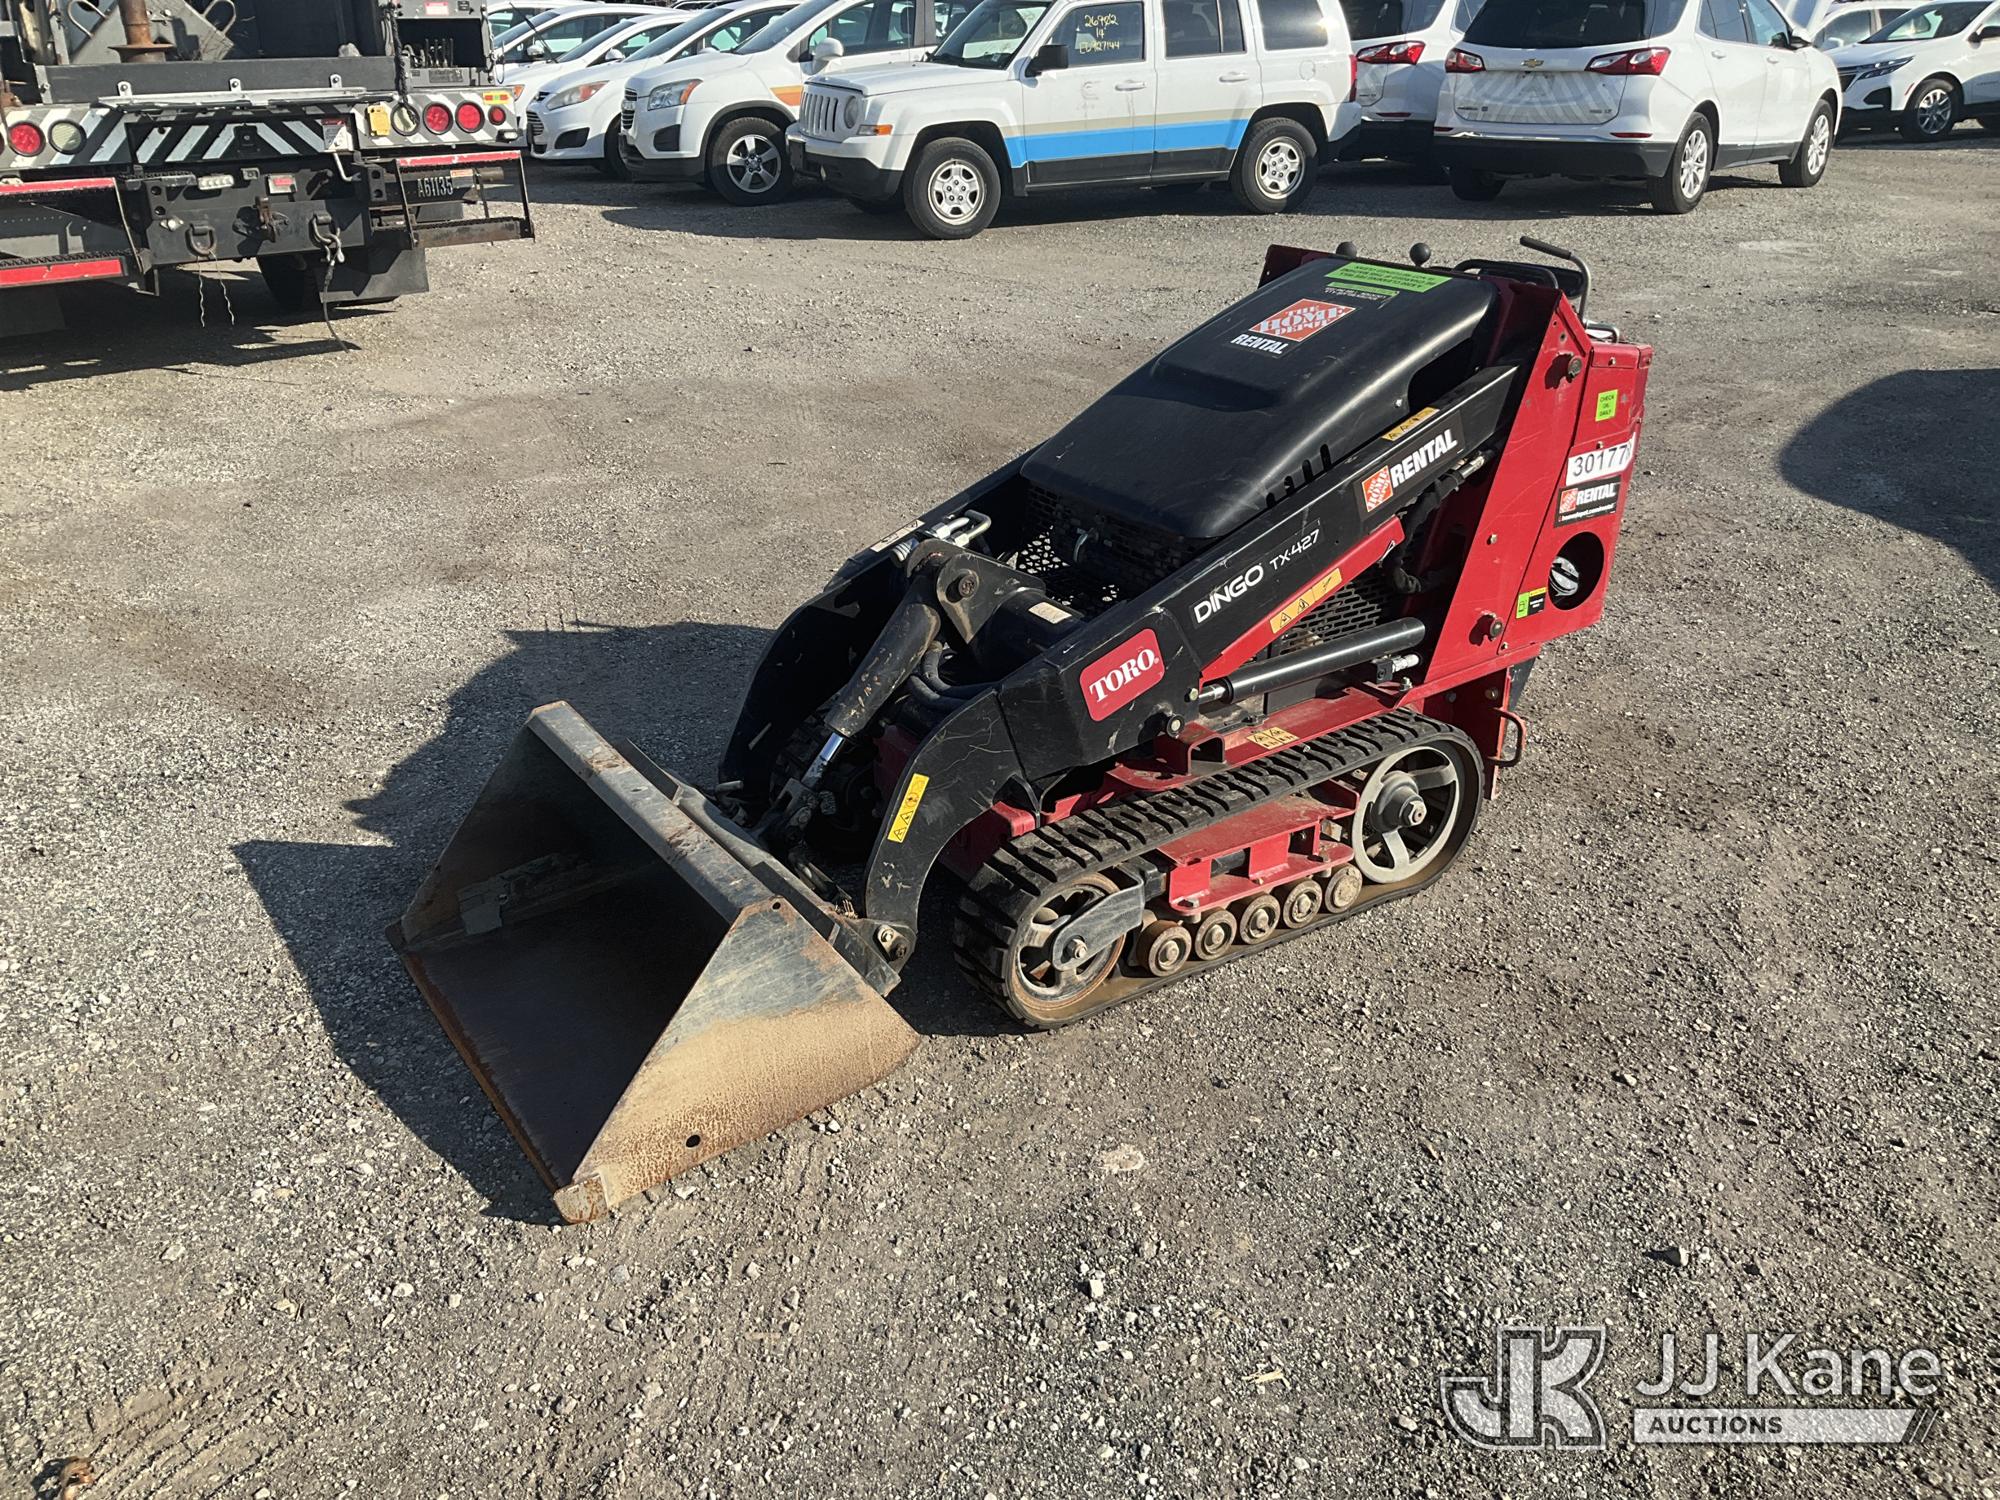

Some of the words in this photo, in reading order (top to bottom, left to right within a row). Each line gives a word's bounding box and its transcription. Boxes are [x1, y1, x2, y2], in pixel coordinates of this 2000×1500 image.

[417, 176, 454, 198] A61135
[1259, 307, 1346, 333] HOME
[1274, 319, 1329, 336] DEPOT
[1230, 333, 1289, 355] RENTAL
[1390, 429, 1458, 488] RENTAL
[1573, 444, 1628, 477] 30177
[1576, 483, 1616, 505] RENTAL
[1193, 564, 1264, 624] DINGO
[1088, 648, 1156, 703] TORO
